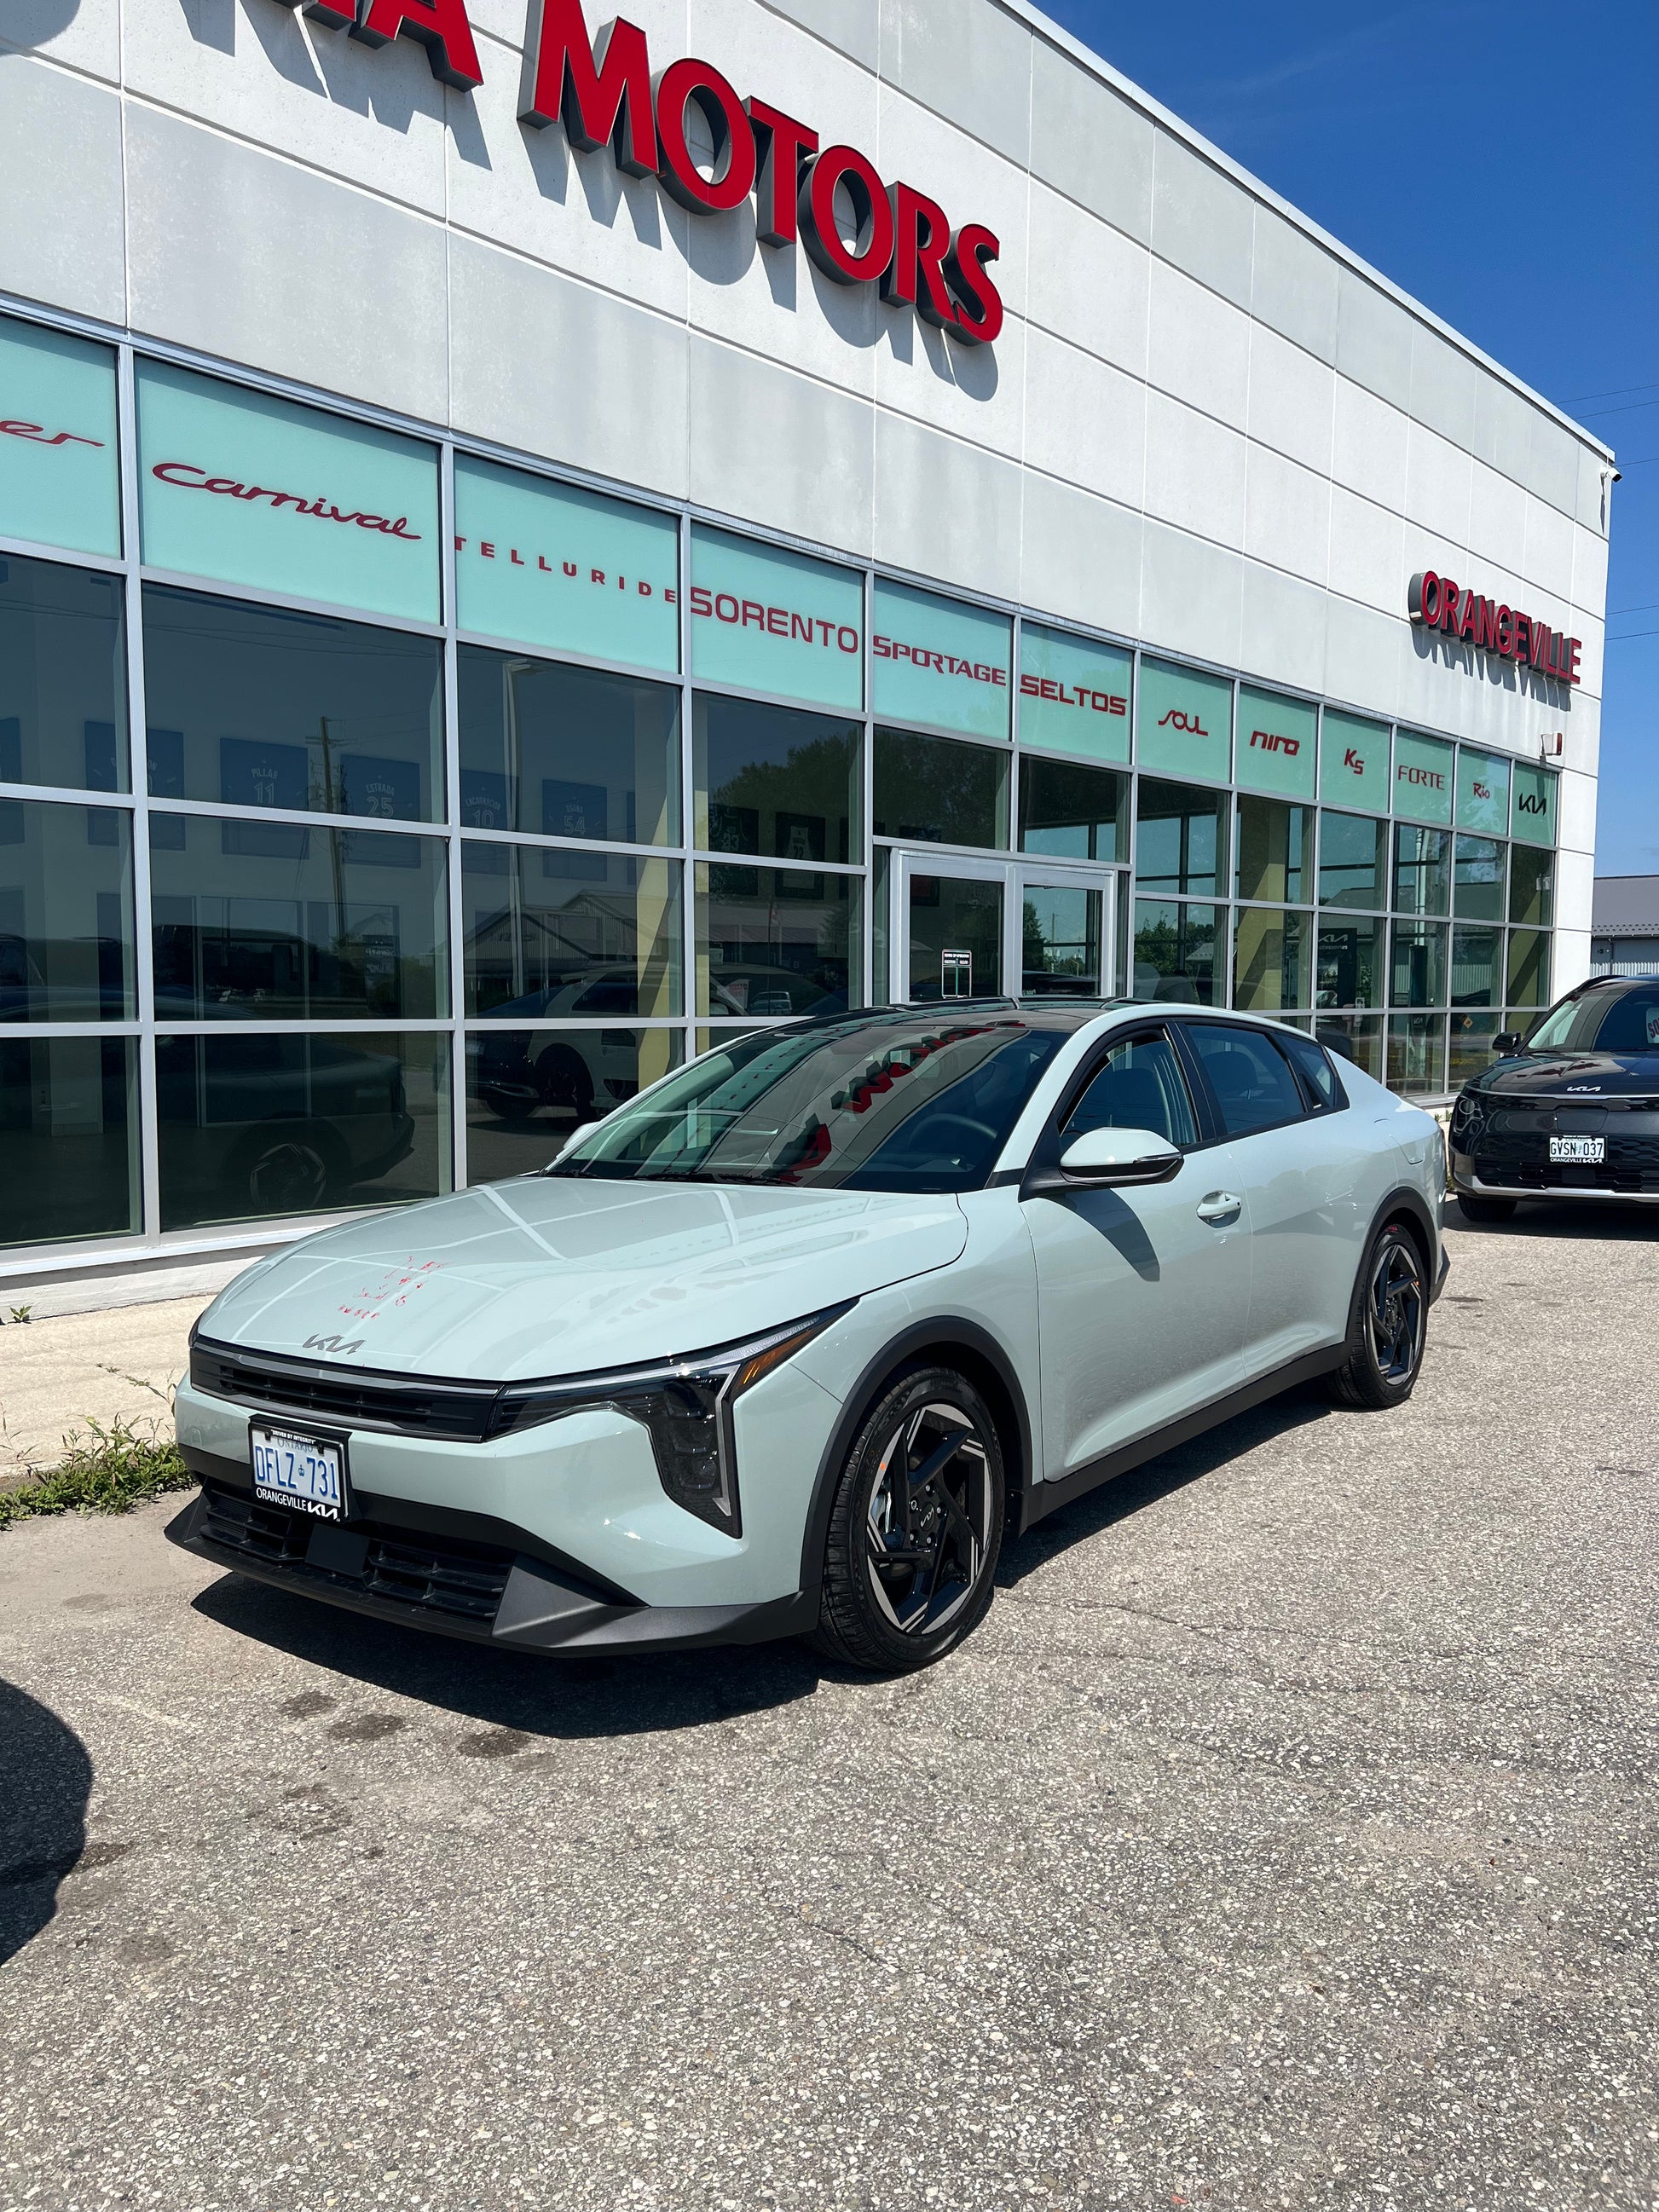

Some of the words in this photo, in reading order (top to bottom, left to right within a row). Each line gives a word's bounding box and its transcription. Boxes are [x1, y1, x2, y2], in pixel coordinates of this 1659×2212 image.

[535, 0, 1003, 343] MOTORS
[153, 463, 420, 540] Carnival
[454, 536, 676, 604] TELLURIDE
[691, 586, 858, 655] SORENTO
[1420, 570, 1582, 684] ORANGEVILLE
[873, 635, 1007, 686] SPORTAGE
[1020, 674, 1128, 716] SELTOS
[251, 768, 279, 779] PILLAR
[1344, 748, 1364, 775] K5
[1397, 765, 1445, 790] FORTE
[1472, 783, 1490, 800] Rio
[1518, 793, 1547, 816] KIA
[367, 795, 394, 817] 25
[472, 809, 494, 829] 10
[564, 815, 587, 835] 54
[1550, 1142, 1576, 1156] GVSN
[1583, 1142, 1604, 1157] 037
[302, 1332, 367, 1355] KIA
[255, 1446, 297, 1489] DFLZ
[307, 1457, 338, 1499] 731
[256, 1487, 307, 1511] ORANGEVILLE
[307, 1500, 338, 1520] KIA
